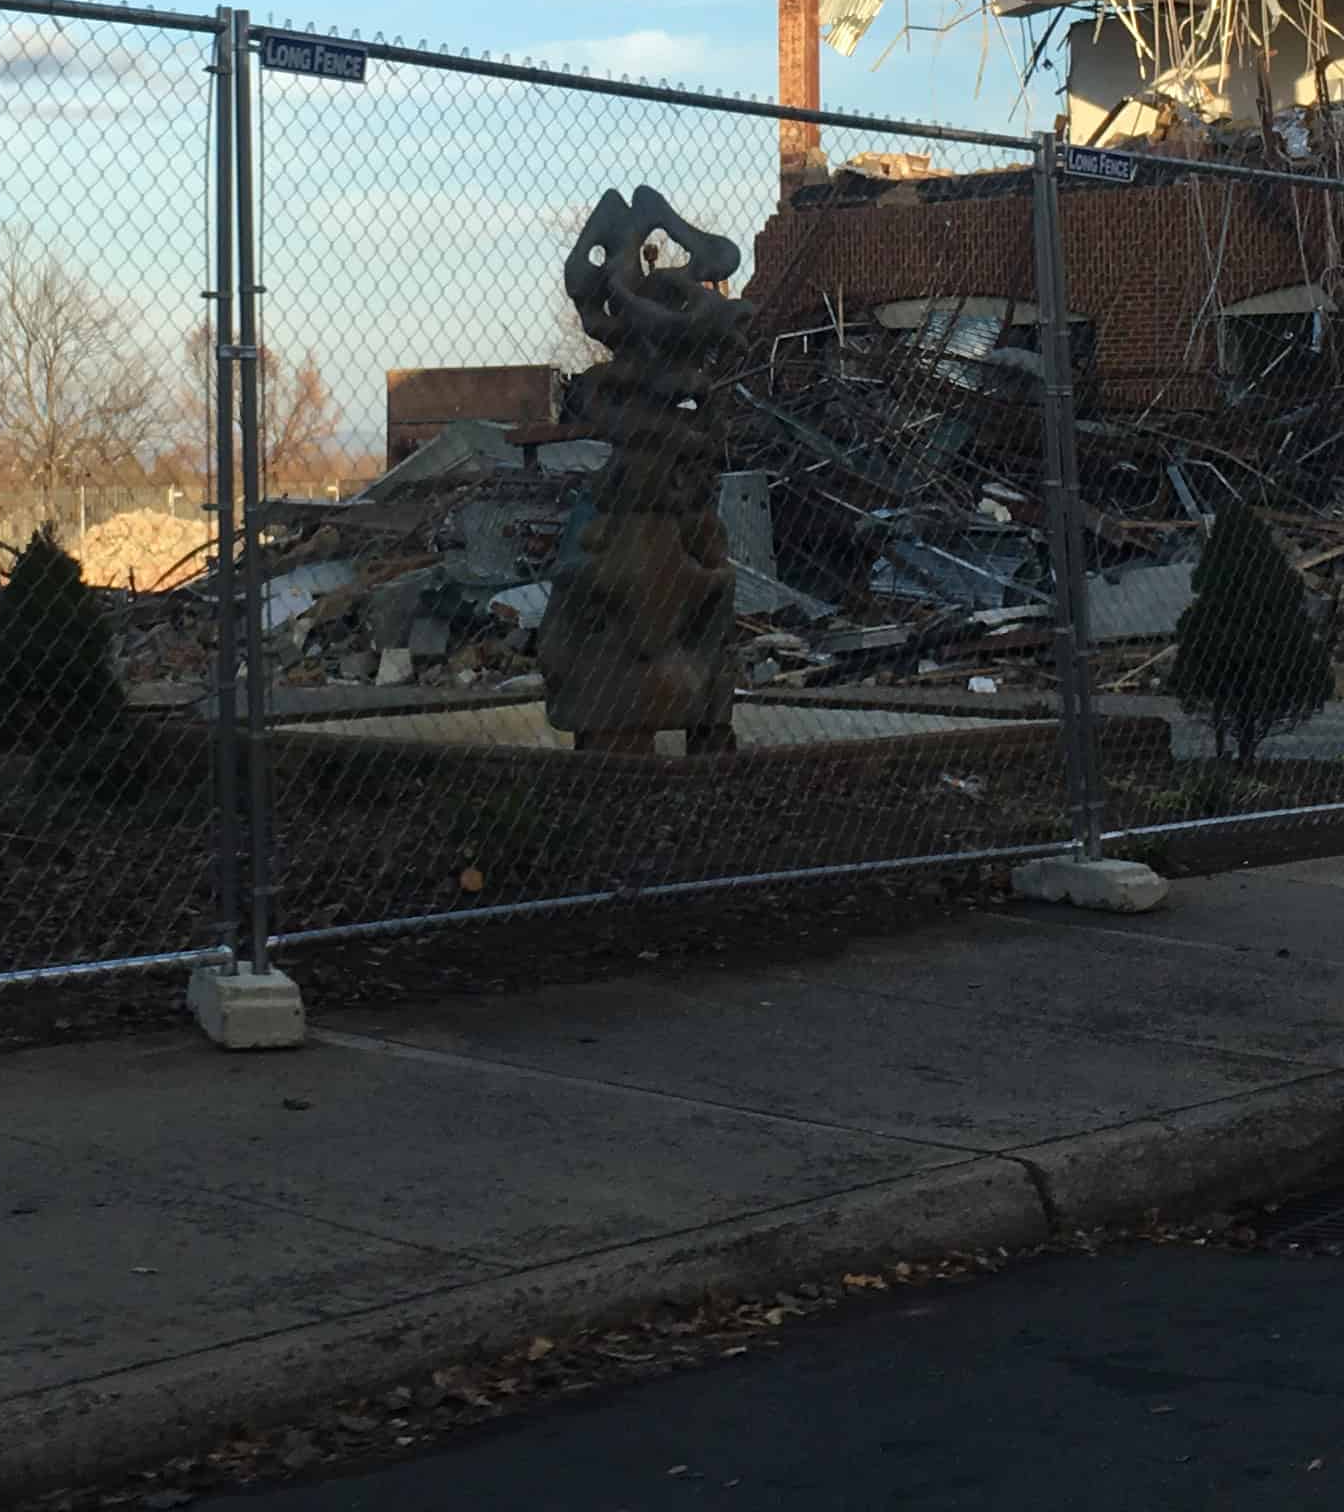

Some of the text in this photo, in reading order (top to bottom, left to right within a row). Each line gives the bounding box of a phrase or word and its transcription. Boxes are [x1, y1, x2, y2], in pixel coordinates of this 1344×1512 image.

[266, 38, 362, 78] LONG FENCE
[1069, 149, 1129, 178] LONG FENCE
